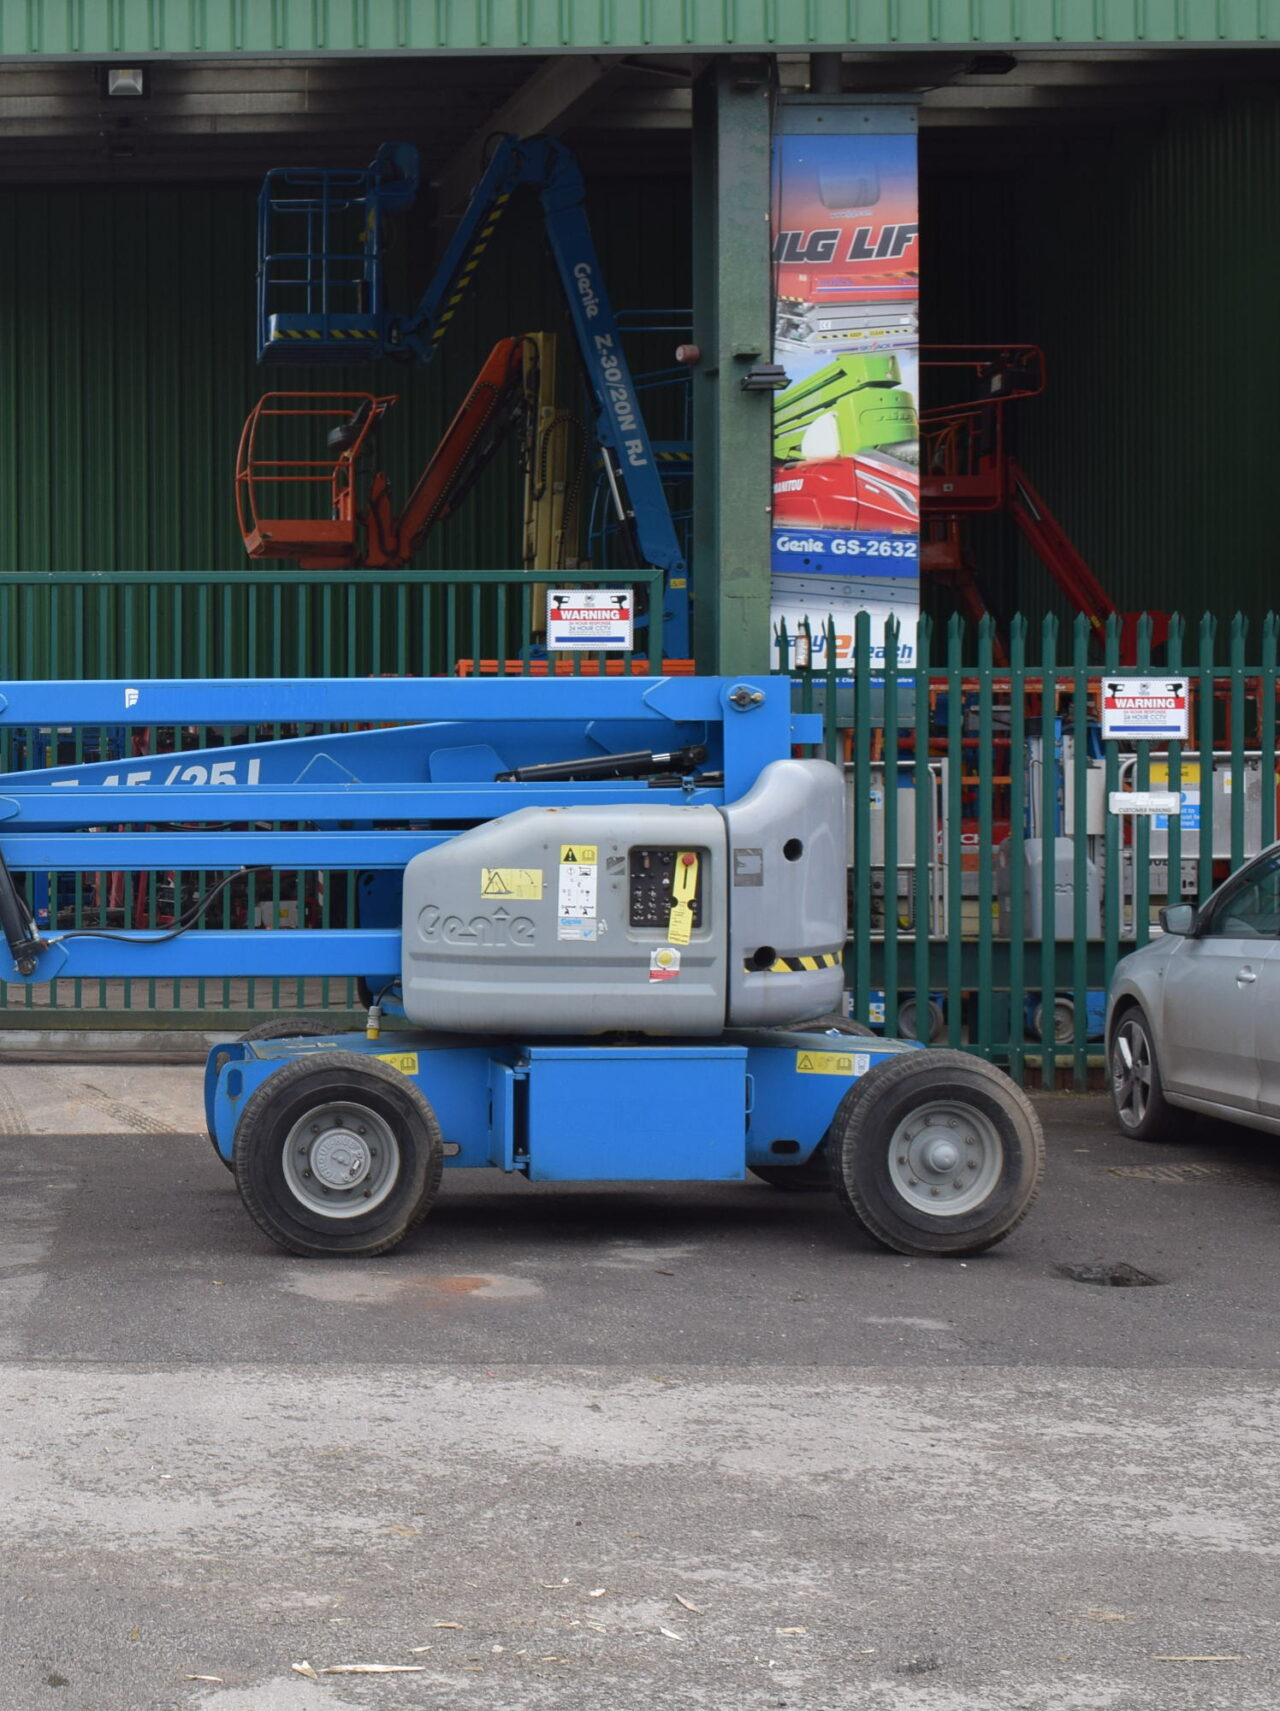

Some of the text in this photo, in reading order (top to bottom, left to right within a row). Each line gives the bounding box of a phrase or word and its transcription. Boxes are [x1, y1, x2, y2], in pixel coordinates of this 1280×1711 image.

[773, 228, 842, 263] JLG
[574, 262, 599, 321] Genie
[624, 439, 648, 467] RJ
[776, 537, 917, 557] Genie GS-2632
[560, 609, 620, 620] WARNING
[1114, 698, 1176, 708] WARNING
[418, 904, 535, 946] Genie
